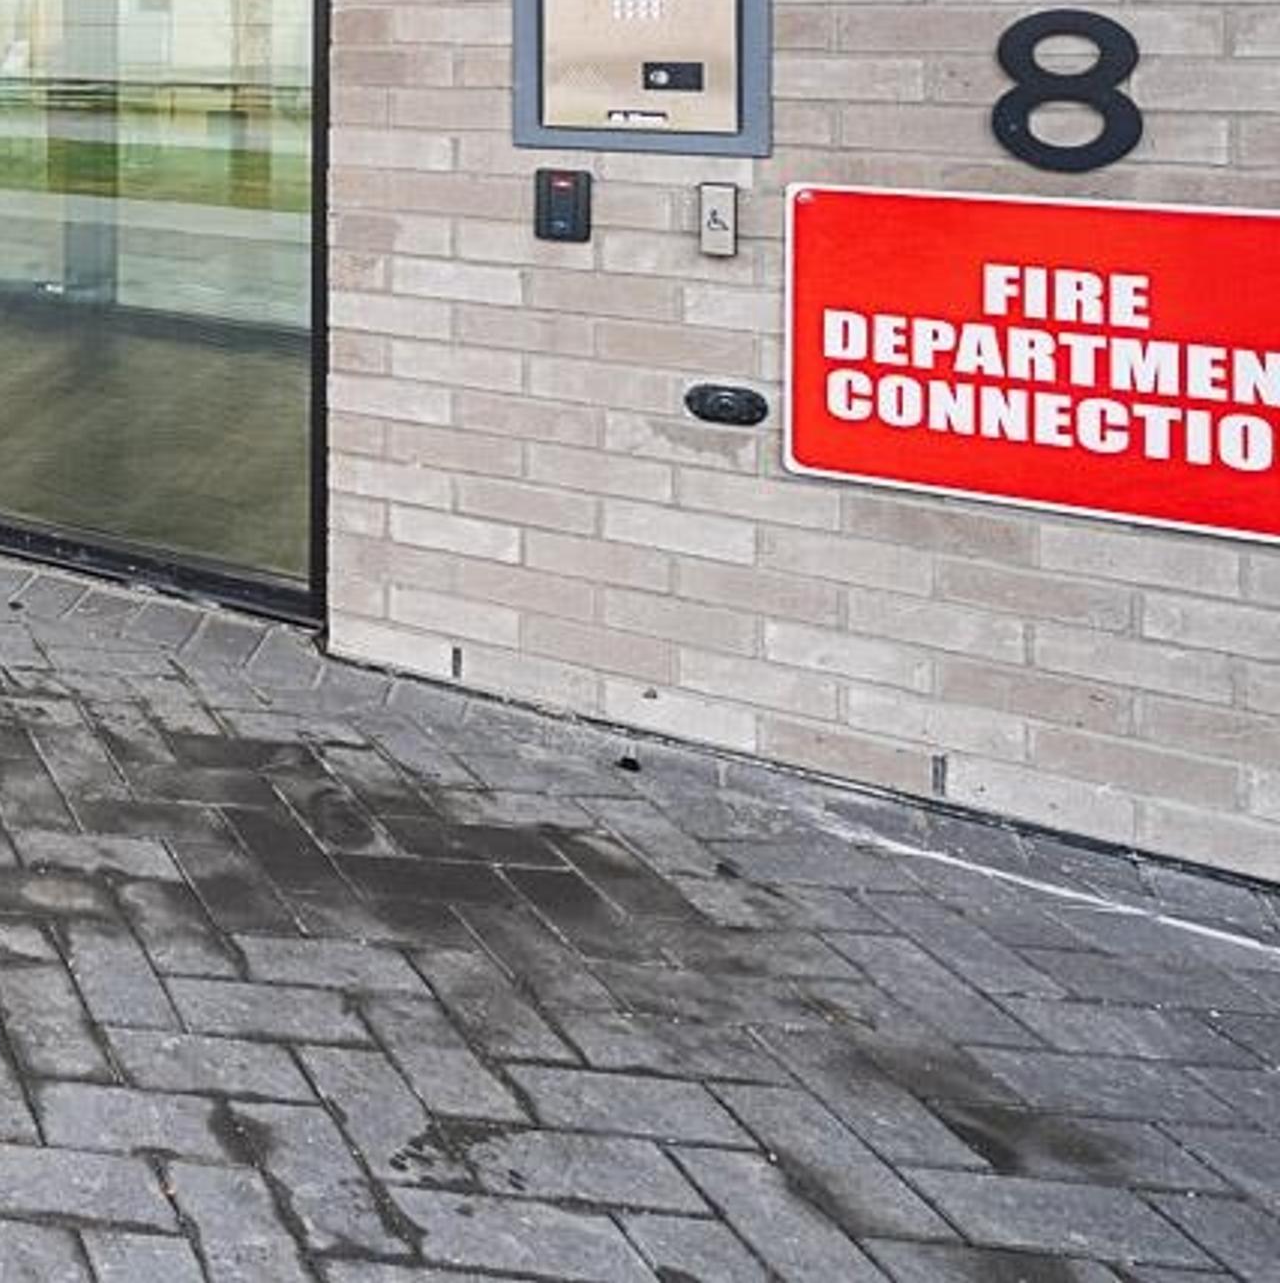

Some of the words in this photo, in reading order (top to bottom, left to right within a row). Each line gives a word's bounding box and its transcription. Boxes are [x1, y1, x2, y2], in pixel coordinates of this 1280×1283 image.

[982, 262, 1150, 330] FIRE
[823, 307, 1280, 408] DEPARTMEN
[827, 368, 1274, 472] CONNECTIO
